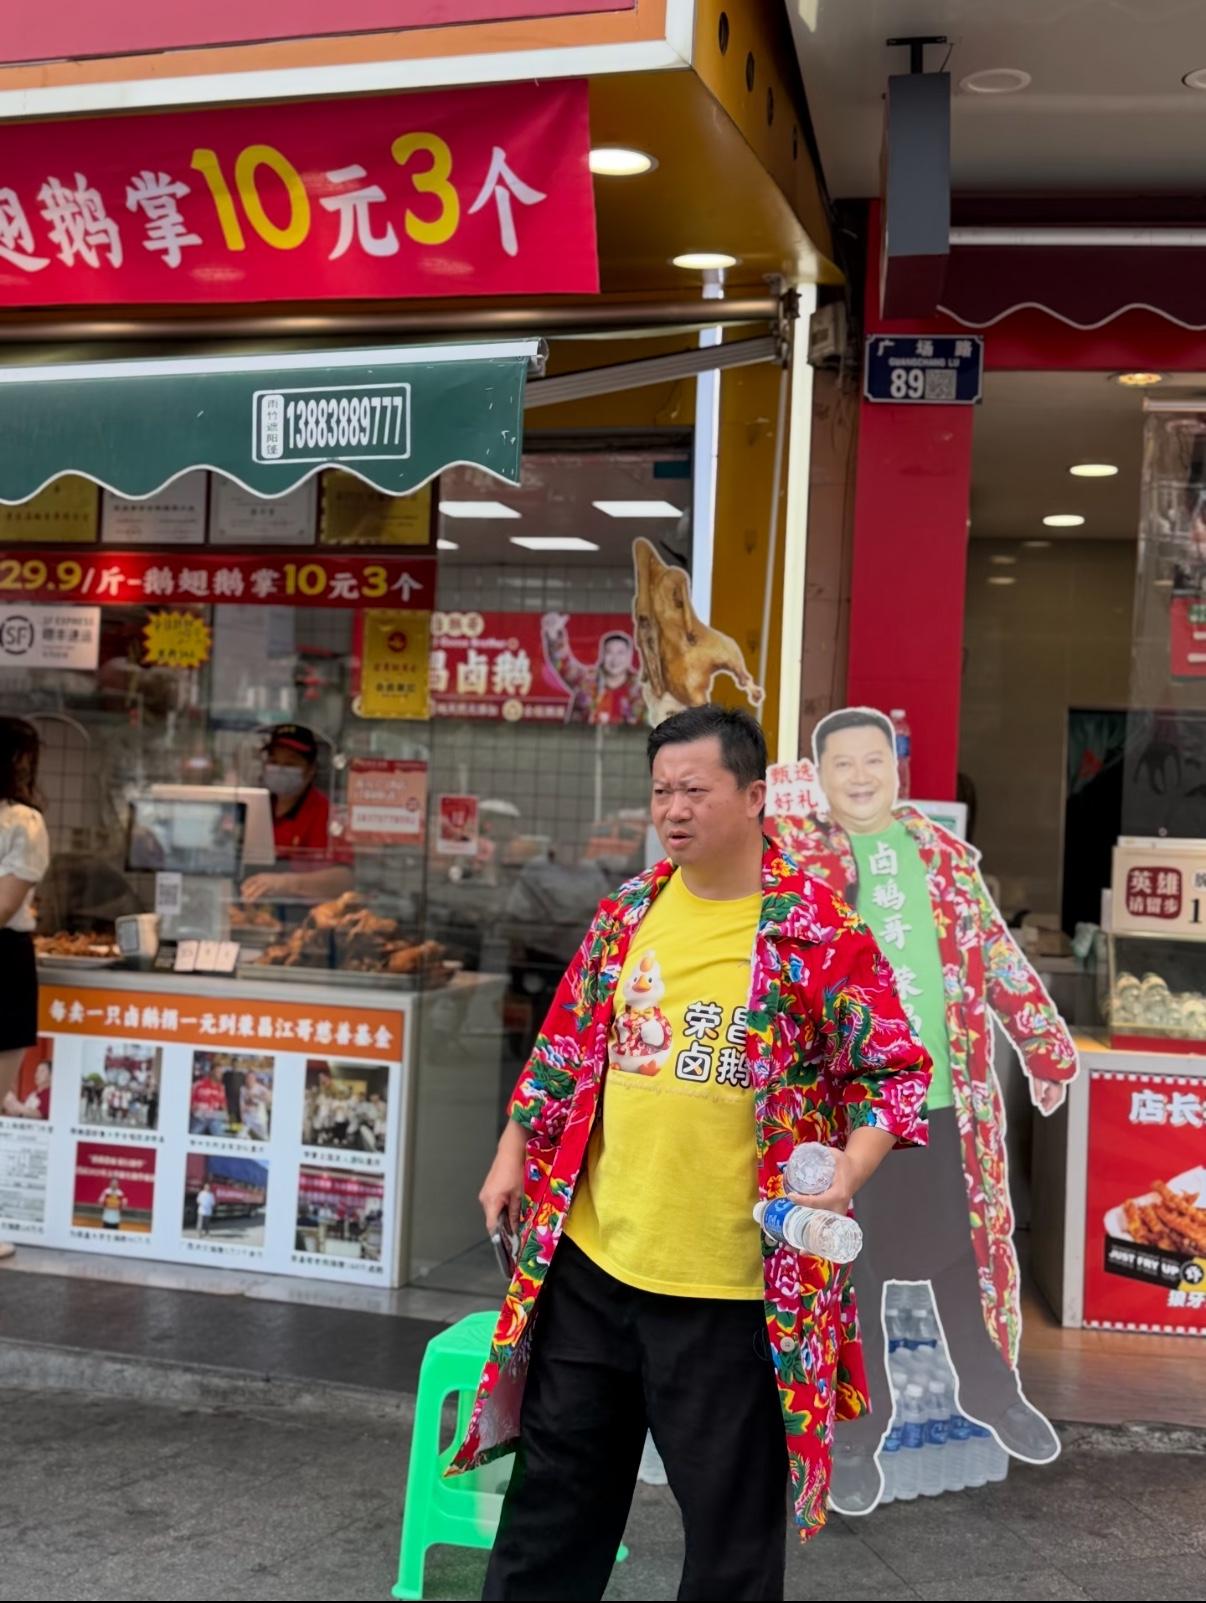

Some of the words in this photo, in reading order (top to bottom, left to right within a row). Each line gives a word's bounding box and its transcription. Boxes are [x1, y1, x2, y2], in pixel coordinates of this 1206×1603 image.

[890, 369, 924, 398] 89
[286, 396, 403, 449] 13883889777
[6, 626, 28, 646] SF
[775, 789, 818, 811] 好礼
[1130, 870, 1180, 895] 英雄
[1128, 1089, 1206, 1128] 店长
[1108, 1249, 1136, 1263] JUST
[1136, 1256, 1160, 1270] FRY
